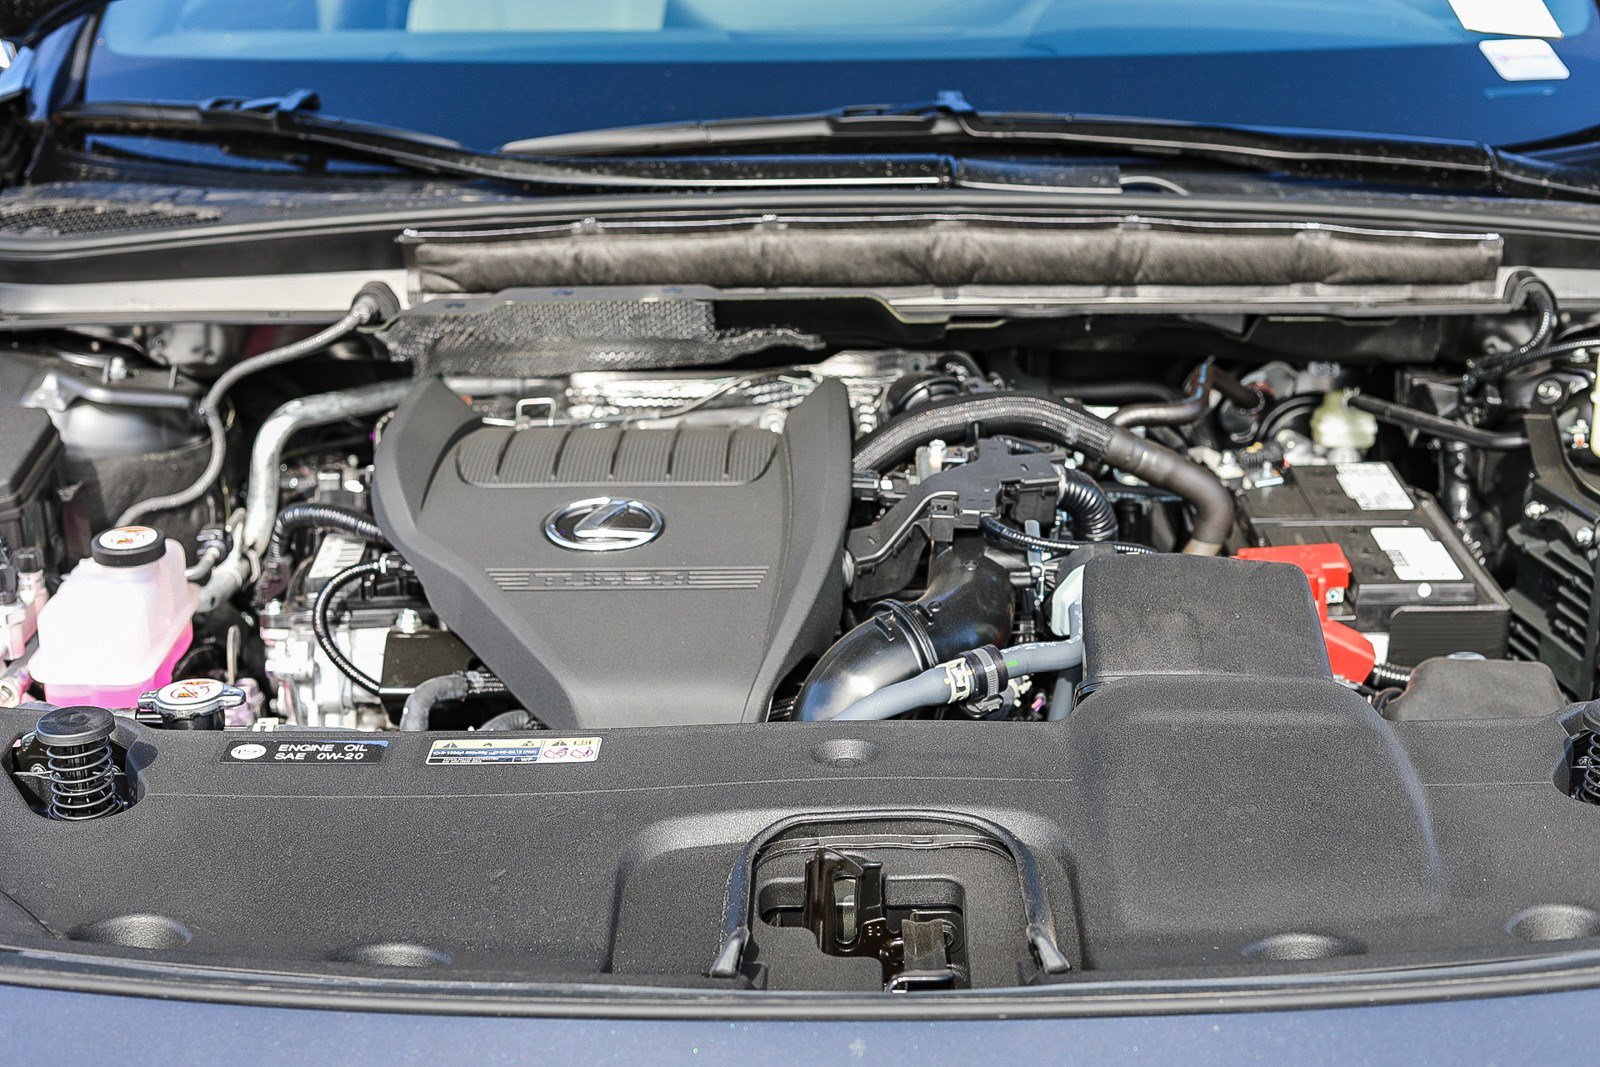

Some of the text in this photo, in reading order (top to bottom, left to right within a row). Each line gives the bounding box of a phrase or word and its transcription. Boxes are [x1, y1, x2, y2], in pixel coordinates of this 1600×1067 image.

[279, 744, 368, 752] ENGINE OIL
[274, 752, 364, 760] SAE 0W-20
